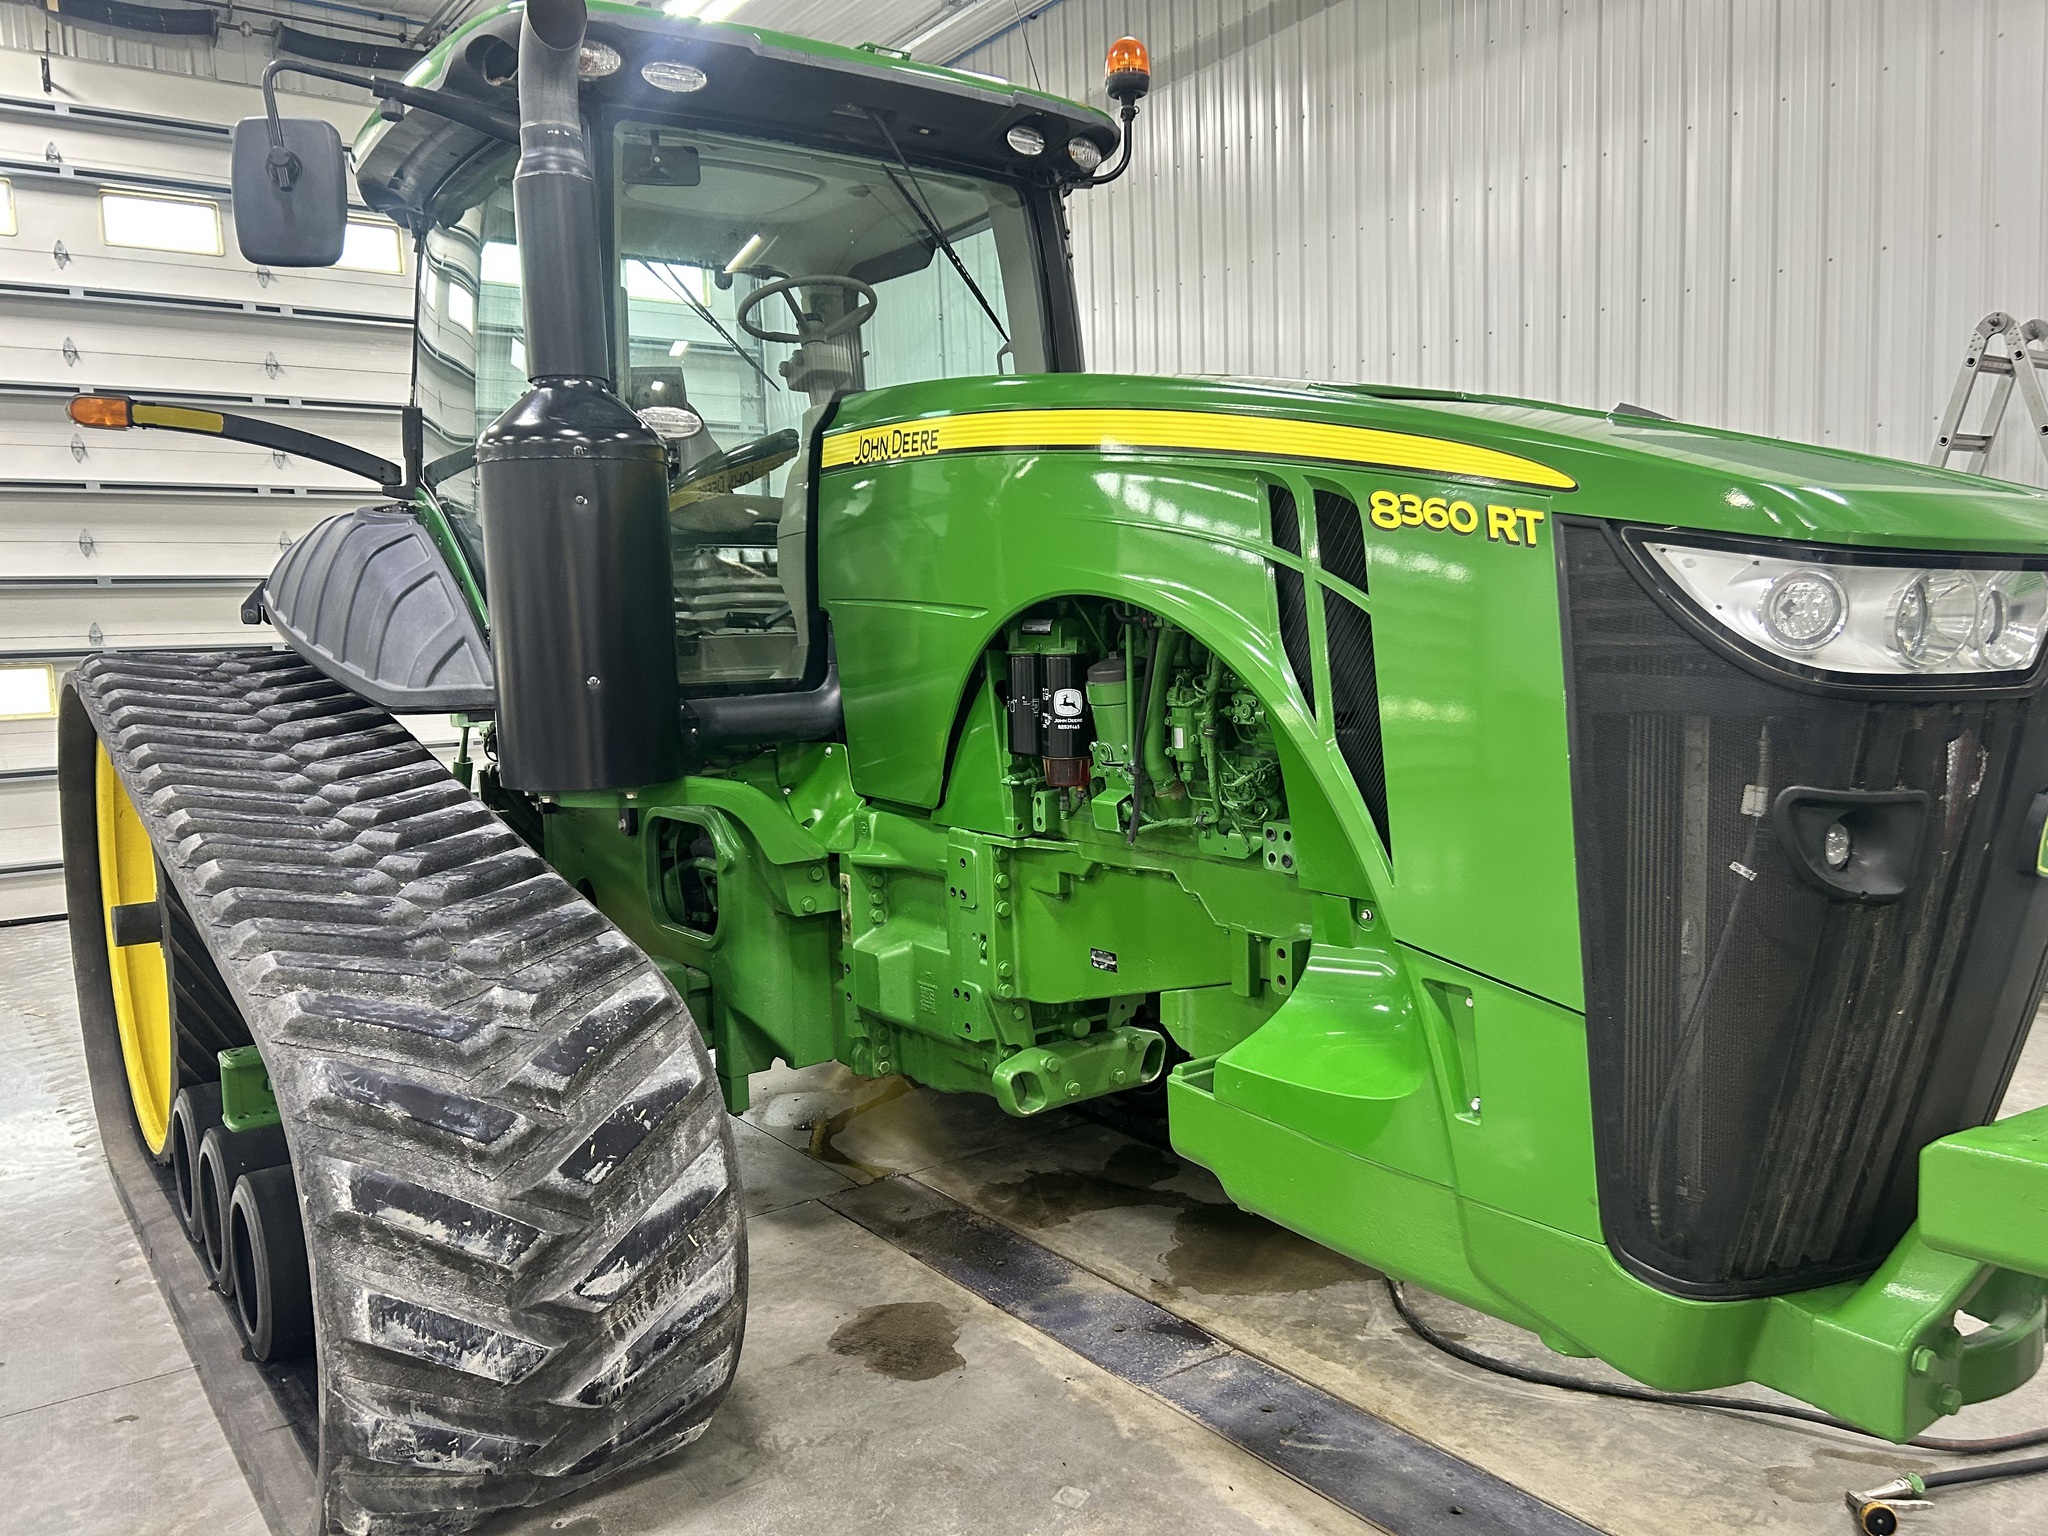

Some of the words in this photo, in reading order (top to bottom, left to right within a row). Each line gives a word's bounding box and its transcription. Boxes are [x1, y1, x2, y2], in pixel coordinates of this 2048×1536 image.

[854, 435, 889, 462] JOHN
[891, 429, 940, 456] DEERE
[1369, 490, 1479, 536] 8360
[1485, 504, 1545, 548] RT
